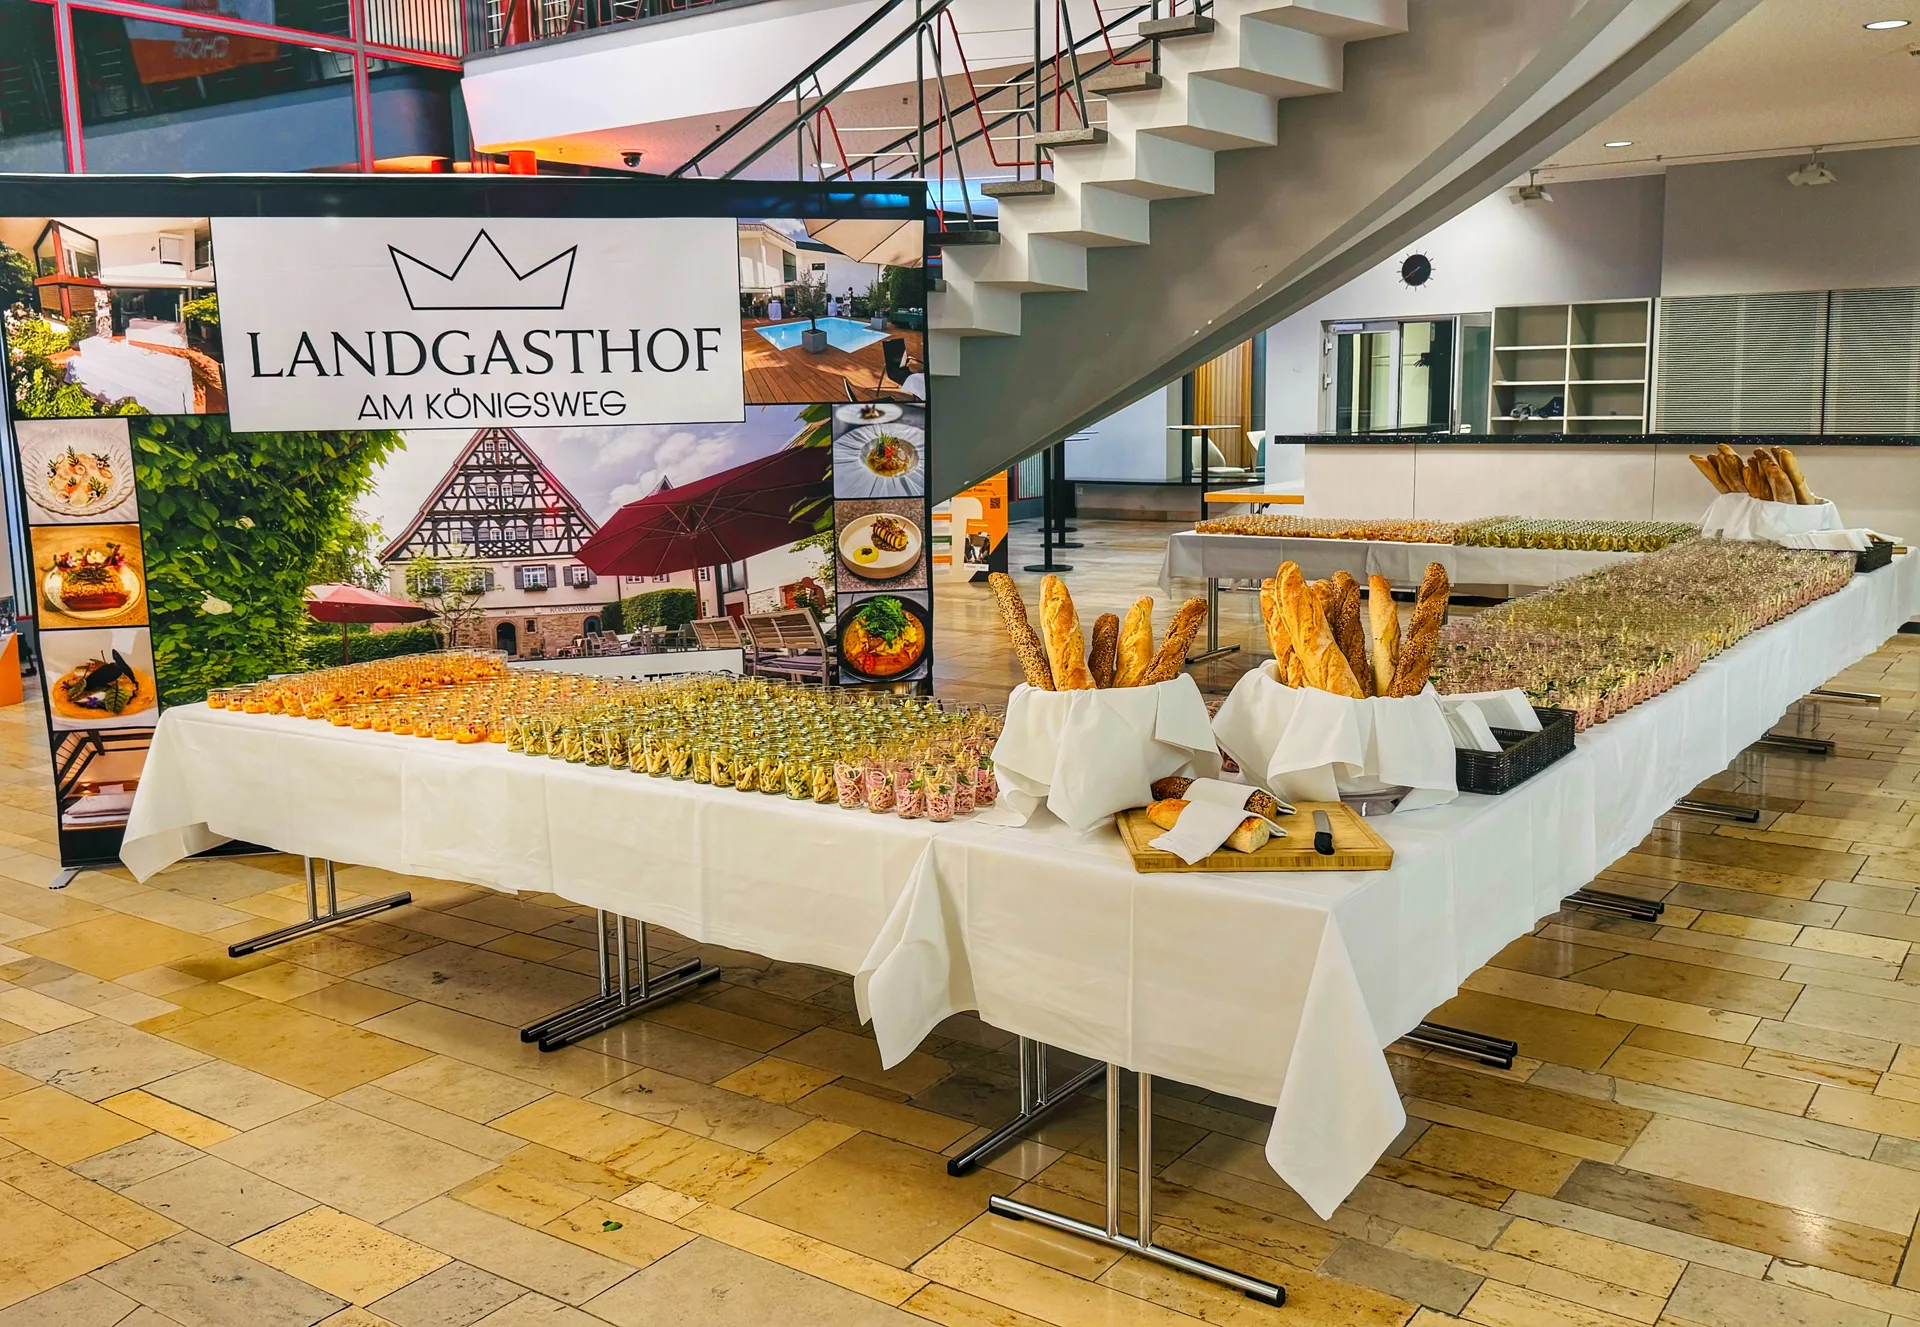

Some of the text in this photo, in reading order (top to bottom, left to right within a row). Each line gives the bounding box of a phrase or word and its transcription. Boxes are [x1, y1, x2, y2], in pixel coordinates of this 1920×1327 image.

[246, 327, 722, 378] LANDGASTHOF
[357, 387, 627, 421] AM KÖNIGSWEG
